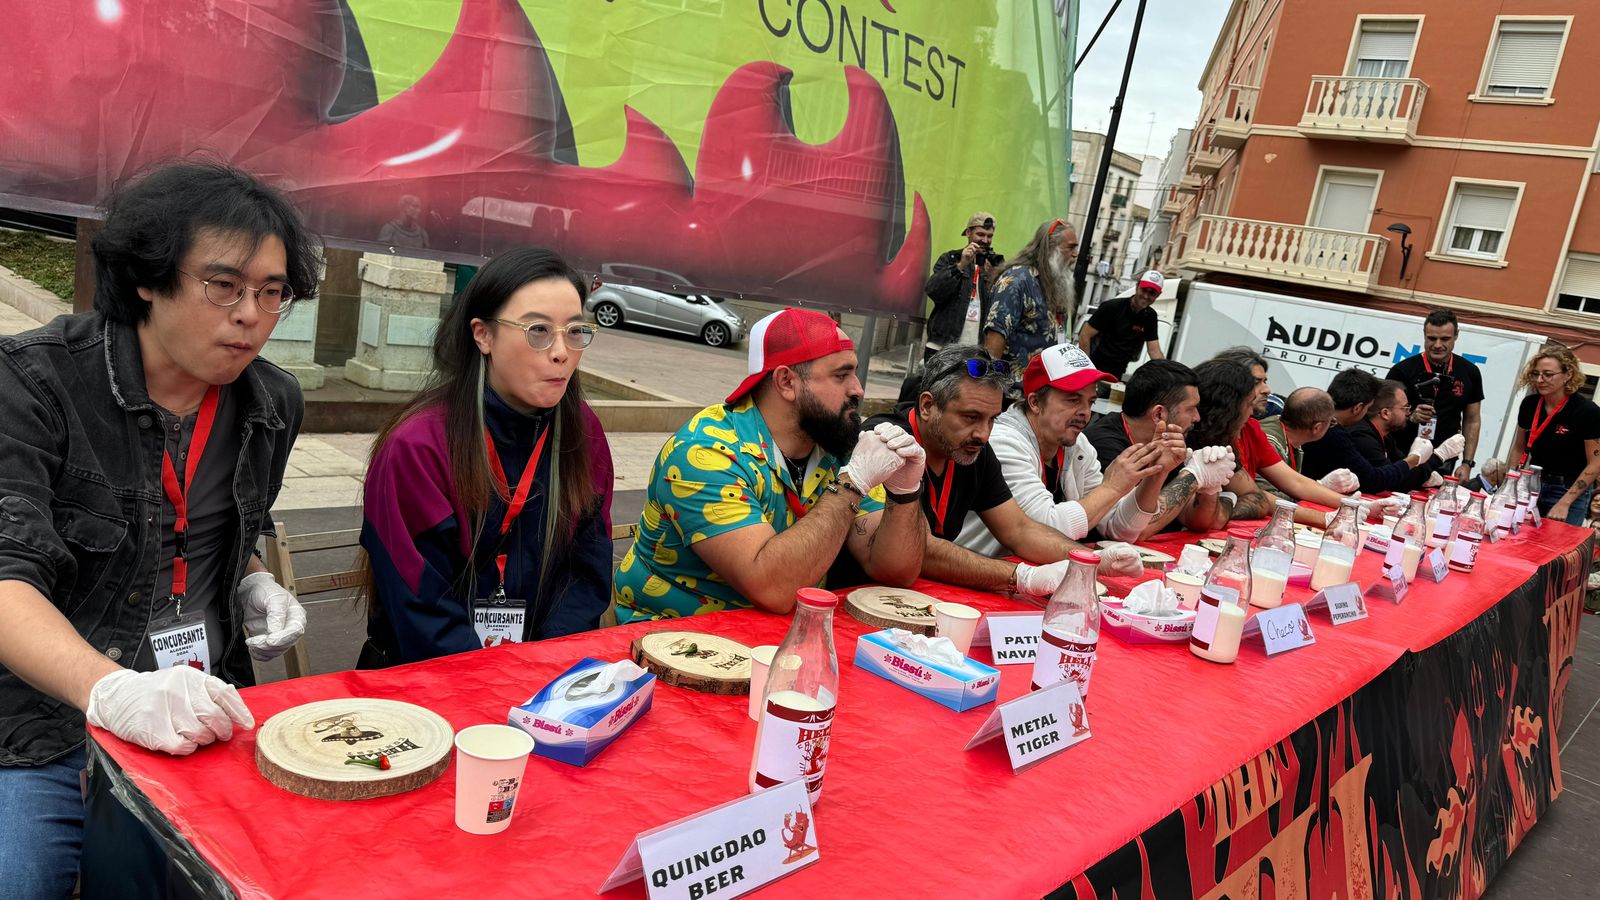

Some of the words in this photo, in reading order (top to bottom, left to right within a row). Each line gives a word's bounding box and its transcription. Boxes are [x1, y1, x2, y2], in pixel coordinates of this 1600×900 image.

[758, 0, 966, 109] CONTEST
[1265, 316, 1487, 365] AUDIO-N
[475, 612, 523, 625] CONCURSANTE
[1163, 622, 1189, 633] Bissú
[152, 627, 205, 652] CONCURSANTE
[1004, 635, 1041, 645] PATI
[890, 655, 923, 678] Bissú
[532, 718, 562, 735] Bissú
[1010, 713, 1058, 739] METAL
[1016, 730, 1061, 756] TIGER
[651, 828, 767, 888] QUINGDAO
[688, 864, 745, 900] BEER
